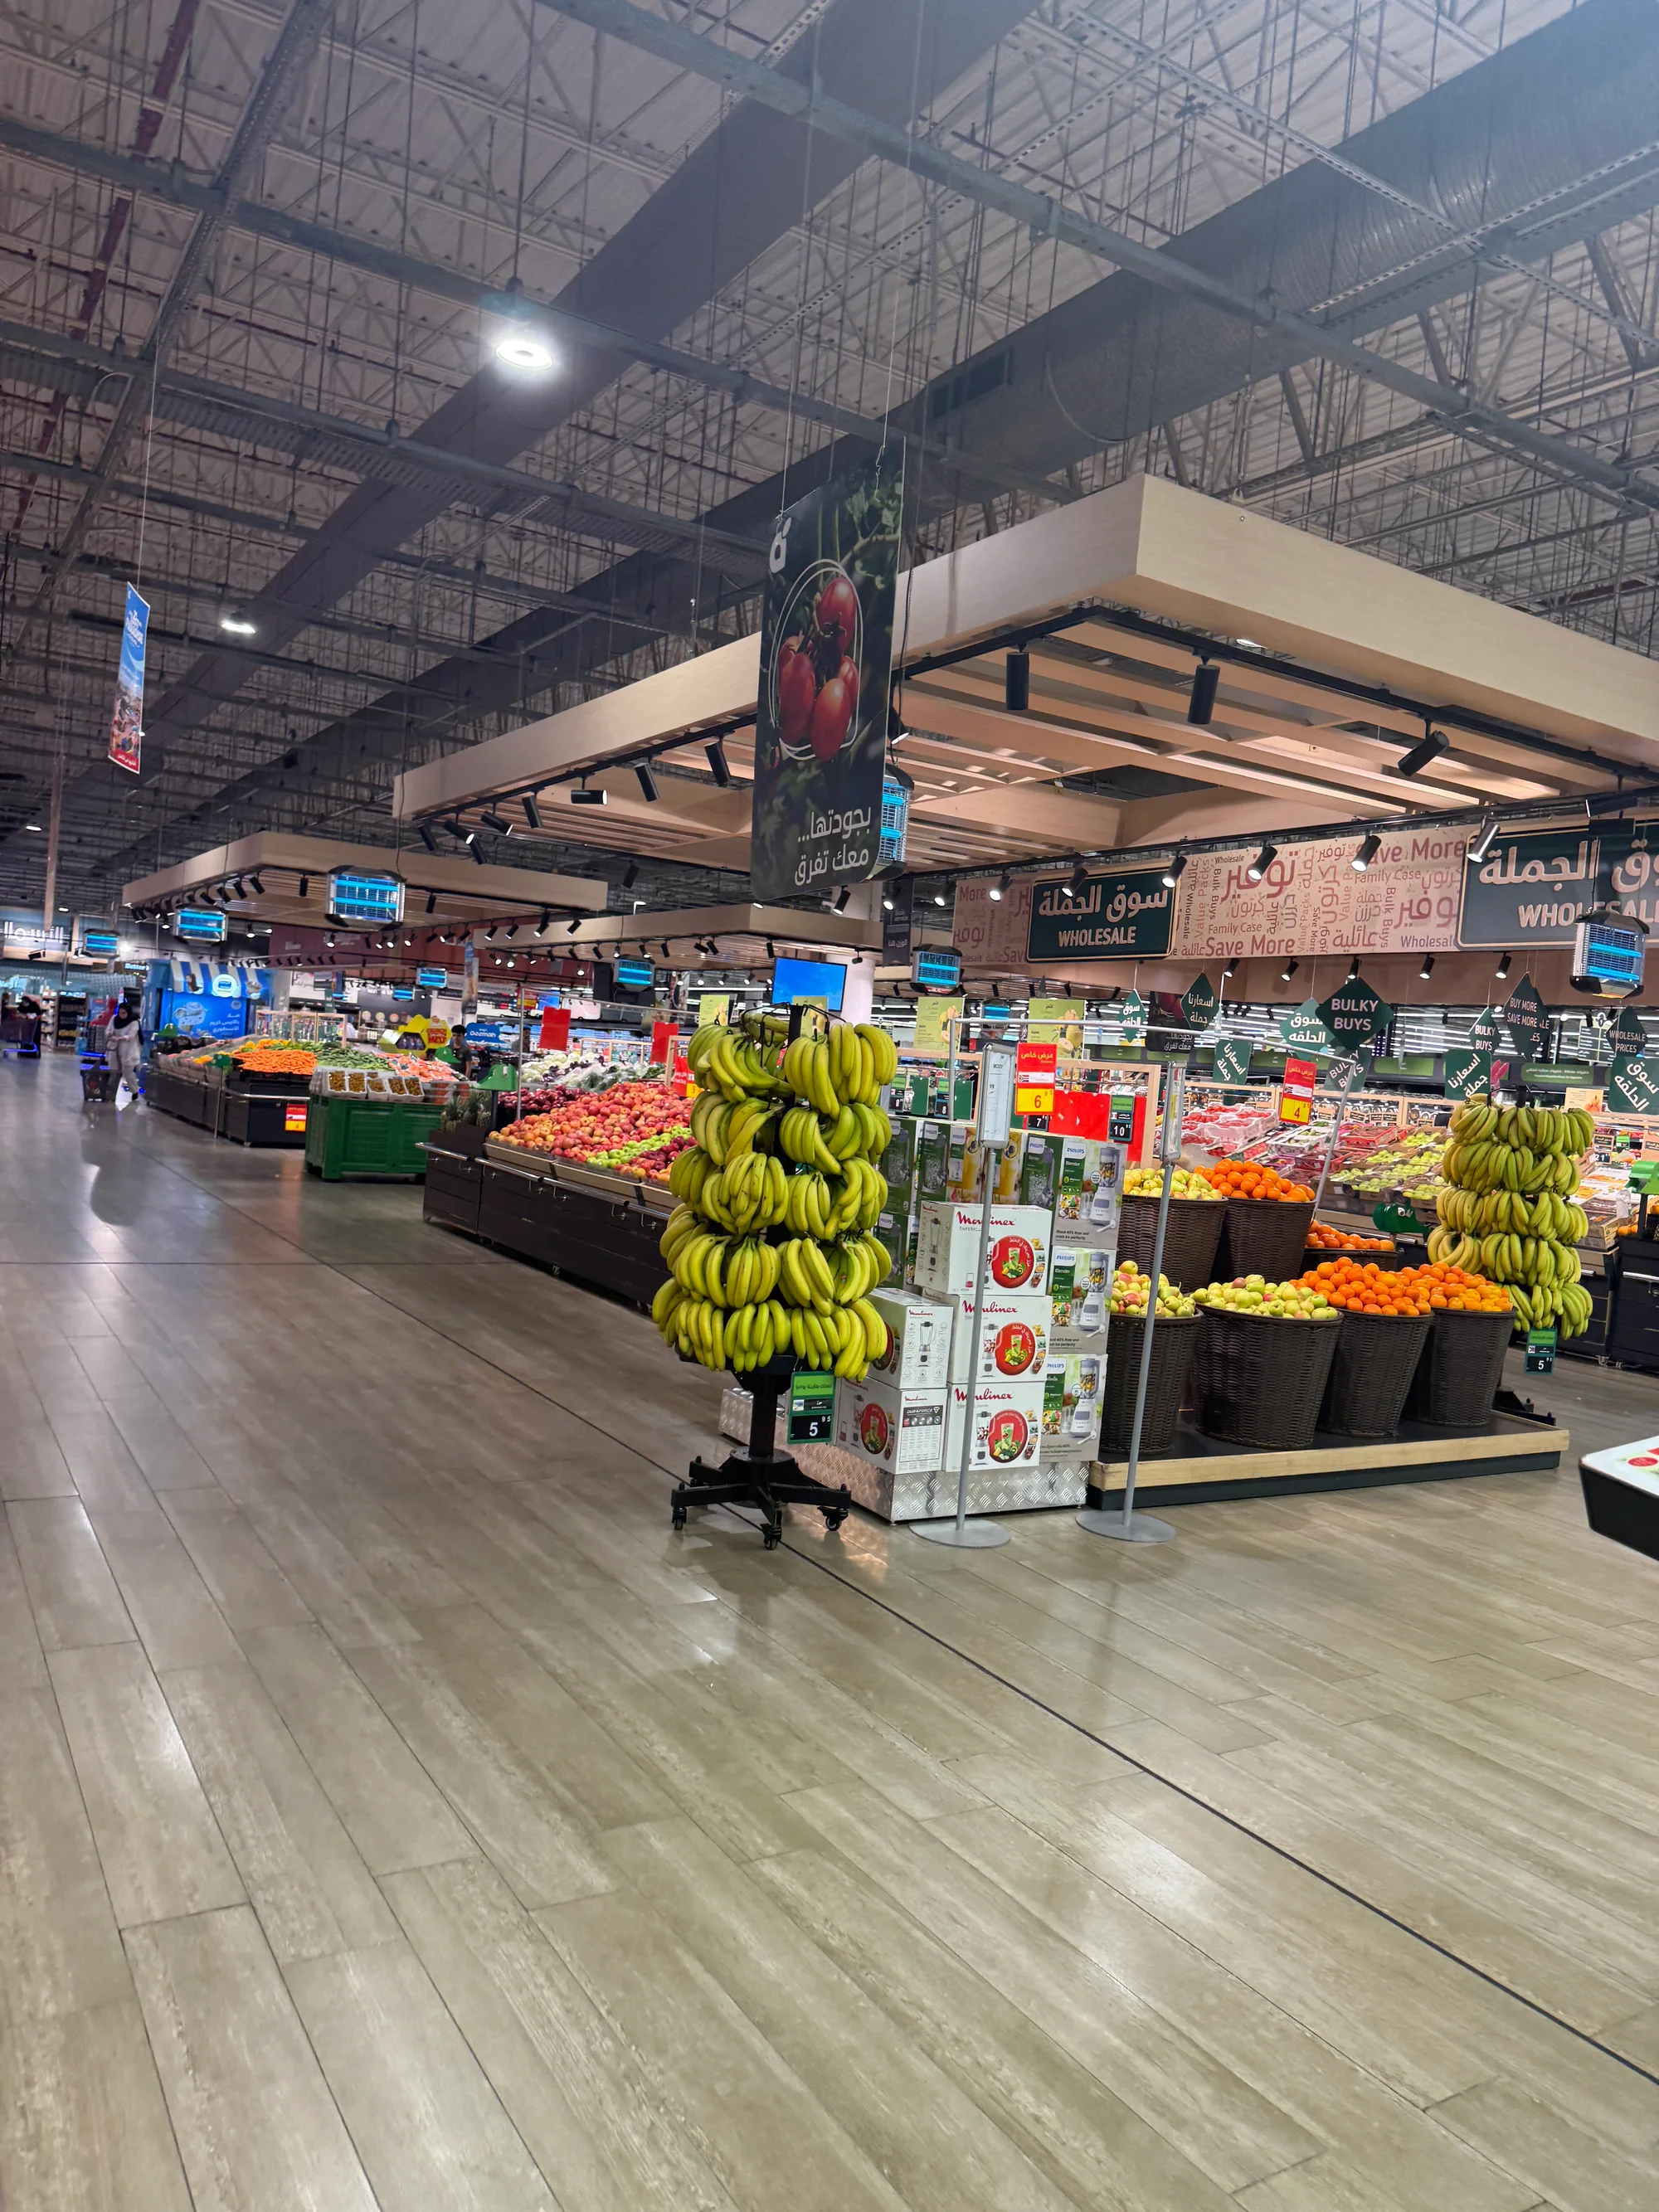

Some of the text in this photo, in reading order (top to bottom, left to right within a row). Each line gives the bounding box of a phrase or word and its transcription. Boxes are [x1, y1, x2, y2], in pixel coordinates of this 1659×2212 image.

[1214, 854, 1245, 864] Wholesale
[1355, 836, 1467, 866] ave More
[794, 843, 869, 886] معك تفرق
[1479, 839, 1601, 892] الجملة
[1354, 868, 1422, 885] Family Case
[958, 885, 987, 902] More
[1194, 859, 1210, 940] Value Packs
[1209, 868, 1222, 921] Bulk Buys
[1038, 883, 1102, 924] الجملة
[1105, 884, 1169, 923] سوق
[1182, 892, 1194, 940] Wholesale
[1380, 886, 1397, 949] Bulk Buys
[1394, 896, 1458, 930] وفير
[1208, 921, 1262, 936] Family Case
[1310, 907, 1321, 952] Save More
[1057, 926, 1137, 948] WHOLESALE
[1400, 934, 1454, 949] Wholesal
[1205, 934, 1296, 957] Save More
[1002, 946, 1024, 963] Sav
[1122, 1002, 1141, 1014] سوق
[1331, 998, 1379, 1014] BULKY
[1510, 997, 1538, 1013] BUY MORE
[1190, 1011, 1209, 1027] جملة
[1333, 1017, 1373, 1032] BUYS
[1506, 1013, 1521, 1024] SAVE
[1521, 1017, 1538, 1029] MORE
[1474, 1024, 1496, 1037] BULKY
[1608, 1028, 1647, 1043] WHOLESALE
[1475, 1039, 1493, 1052] BUYS
[1615, 1042, 1637, 1054] PRICES
[1020, 1050, 1037, 1060] خاص
[1329, 1048, 1360, 1080] BULY
[1337, 1063, 1365, 1089] BS
[1626, 1061, 1659, 1096] سوق
[1034, 1094, 1043, 1109] 6
[1294, 1106, 1301, 1120] 4
[1036, 1118, 1043, 1128] 7
[1113, 1125, 1126, 1137] 10
[956, 1211, 1015, 1226] Mouinex
[962, 1300, 1019, 1314] Mulinex
[1537, 1359, 1545, 1370] 5
[955, 1388, 1014, 1402] Mulinex
[809, 1422, 819, 1437] 5
